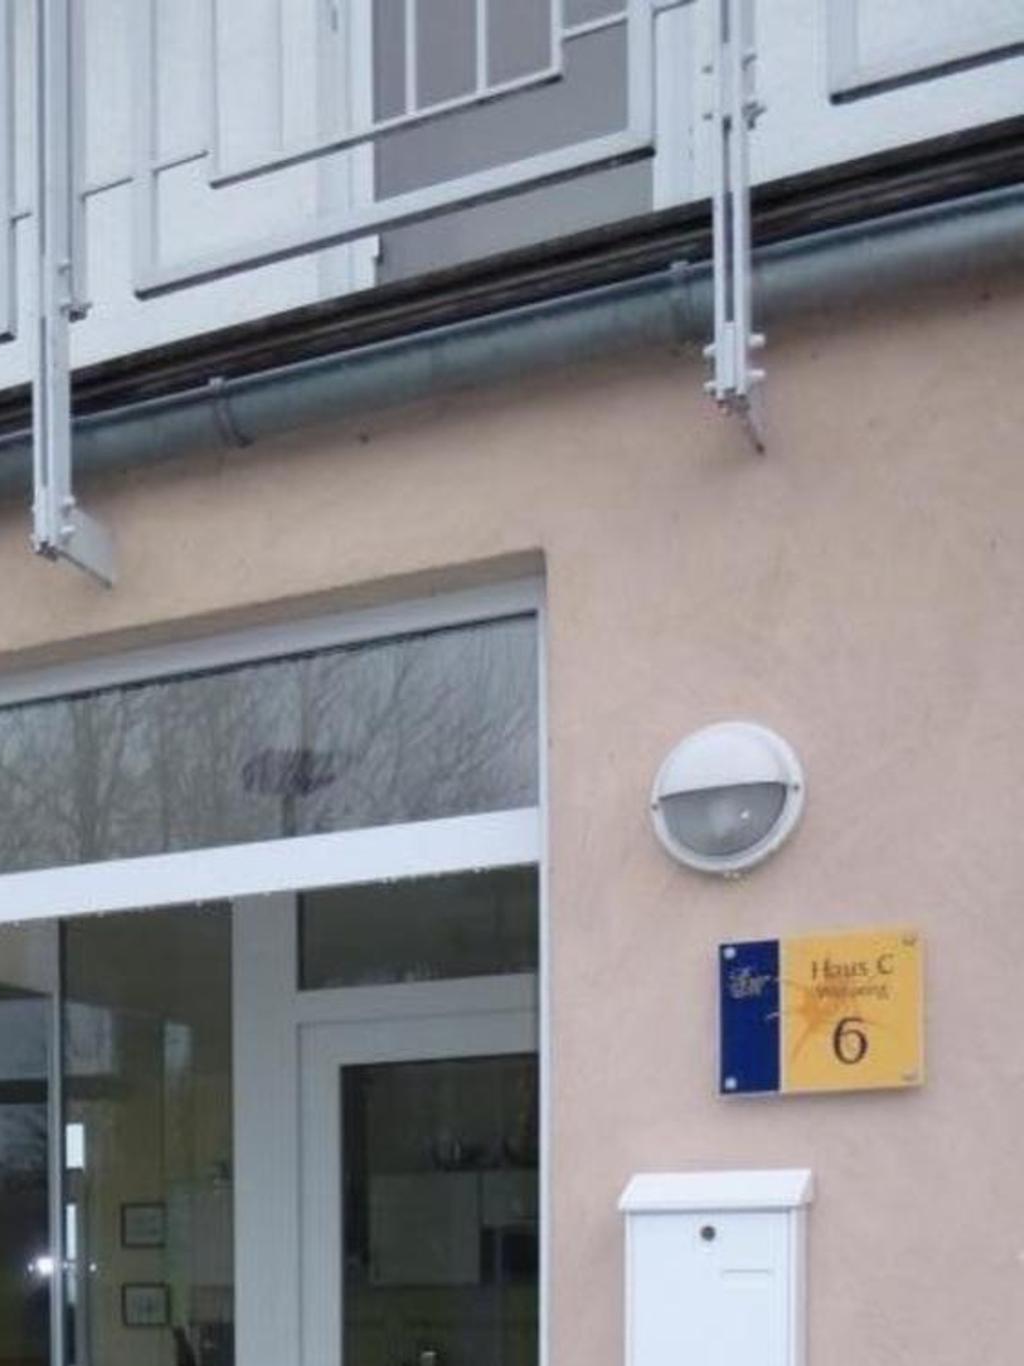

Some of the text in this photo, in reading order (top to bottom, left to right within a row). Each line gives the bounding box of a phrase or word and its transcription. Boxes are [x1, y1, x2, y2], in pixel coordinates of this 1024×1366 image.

[811, 953, 895, 980] Haus C
[833, 1016, 869, 1065] 6
